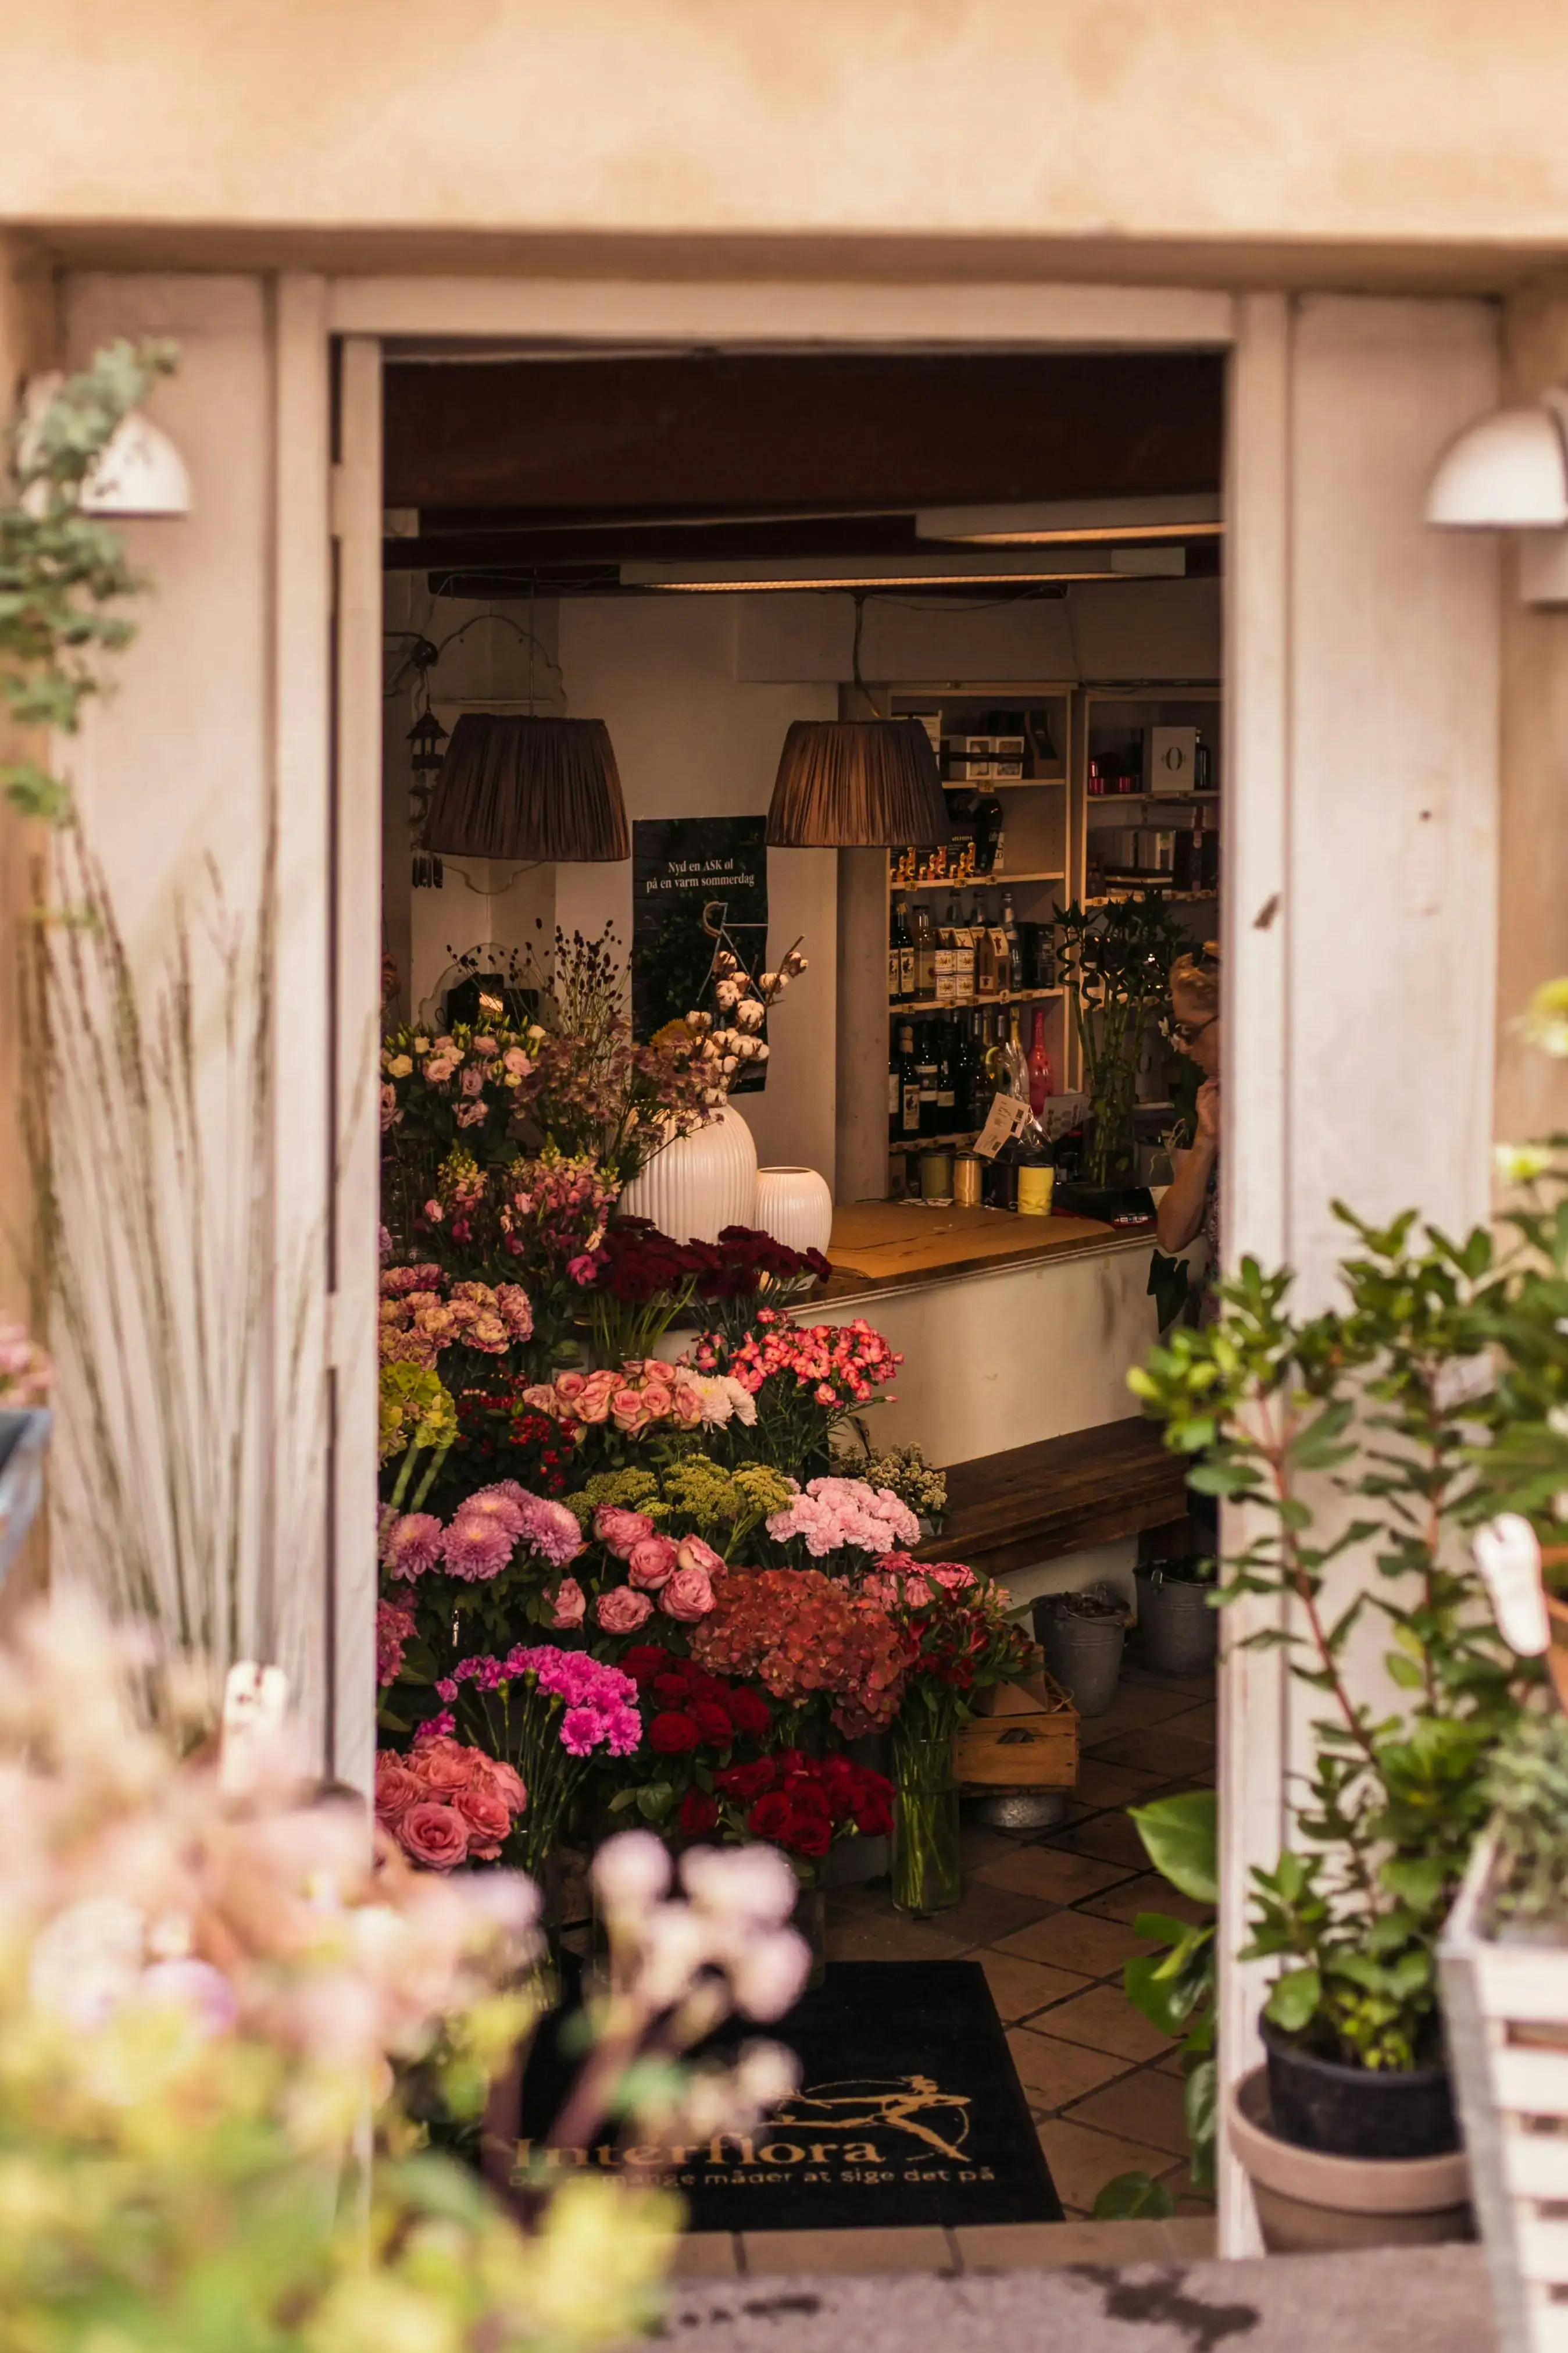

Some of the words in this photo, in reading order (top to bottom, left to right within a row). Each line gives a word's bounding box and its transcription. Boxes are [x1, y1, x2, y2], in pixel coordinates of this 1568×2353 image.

[668, 860, 687, 876] Nyd
[689, 862, 701, 872] en
[703, 859, 723, 871] ASK
[646, 877, 658, 893] på
[660, 879, 672, 889] en
[674, 878, 699, 887] varm
[701, 872, 755, 887] sommerdag
[511, 2132, 886, 2168] Interflora
[802, 2170, 833, 2184] at
[840, 2166, 895, 2186] sige
[903, 2169, 952, 2183] det
[957, 2166, 996, 2184] på
